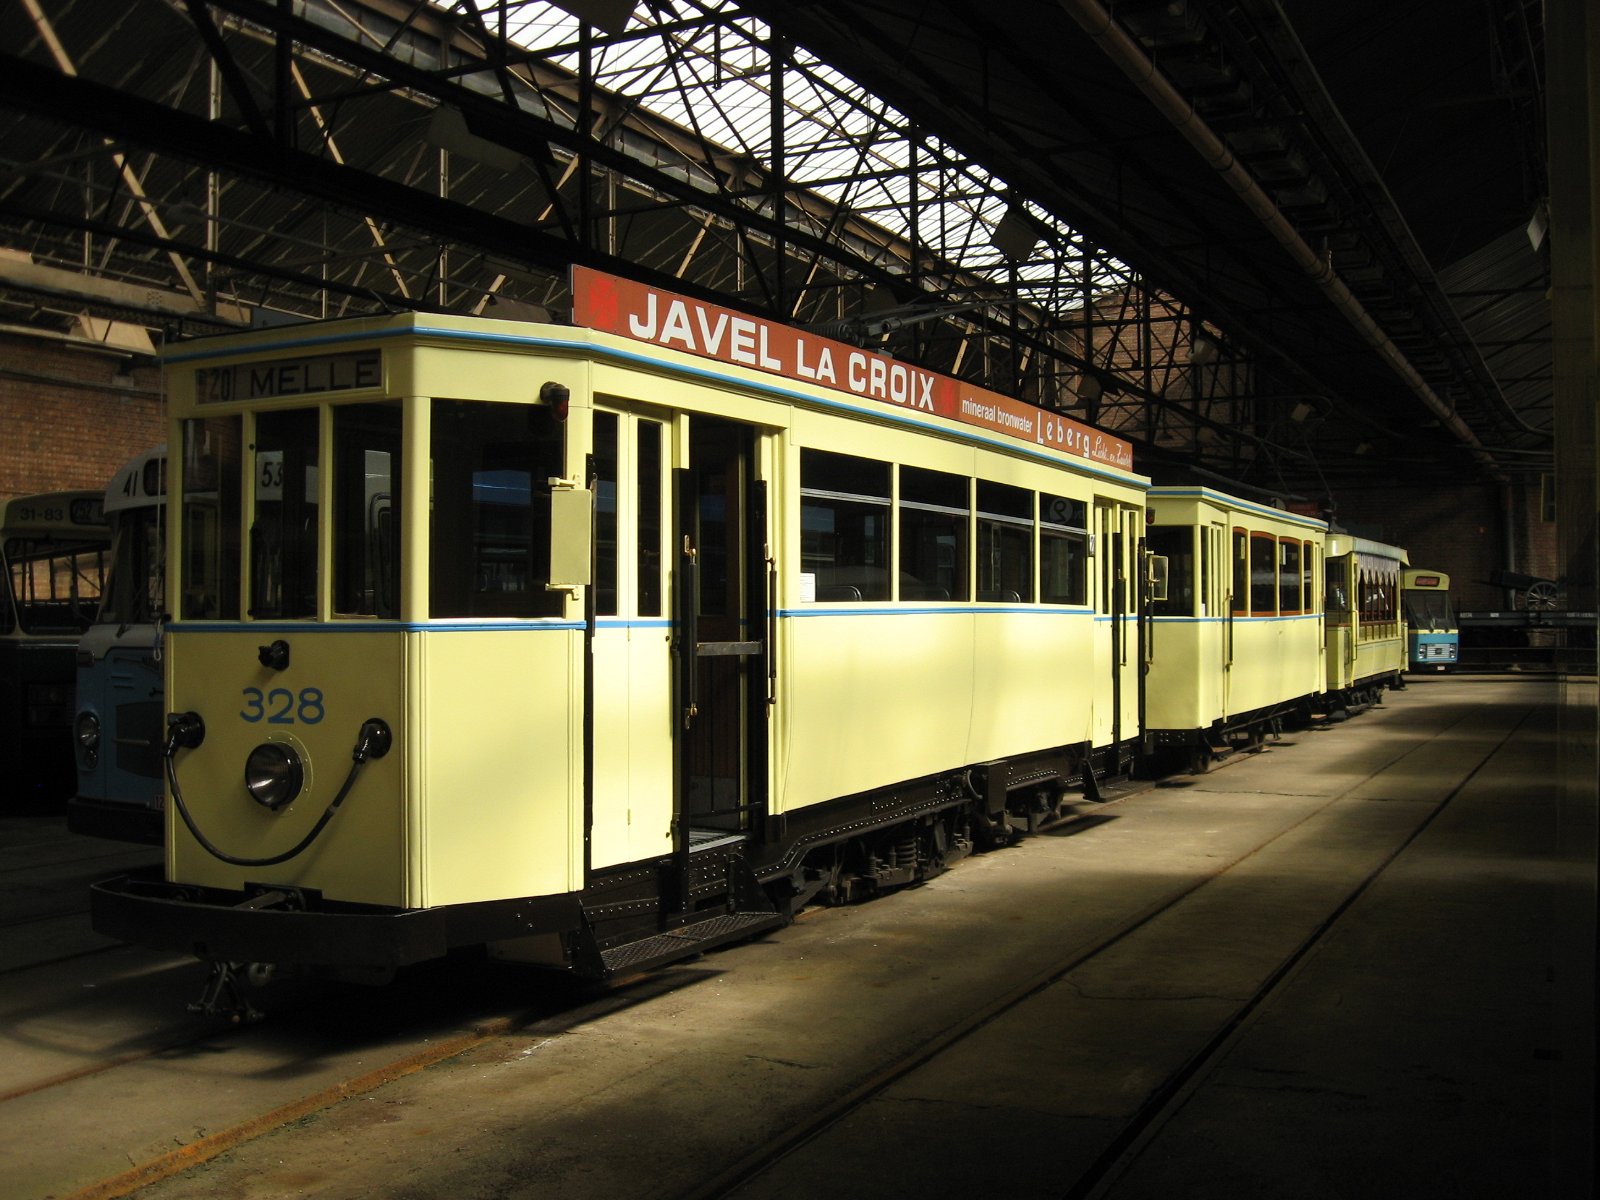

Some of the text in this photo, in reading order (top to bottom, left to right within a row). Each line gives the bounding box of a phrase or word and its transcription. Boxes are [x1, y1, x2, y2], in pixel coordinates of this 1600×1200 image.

[629, 293, 935, 411] JAVEL LA CROIX
[250, 359, 380, 398] MELLE
[962, 397, 996, 422] mineraal
[997, 406, 1033, 433] bronwater
[123, 470, 138, 497] 41
[20, 508, 64, 521] 31-83
[239, 687, 325, 725] 328
